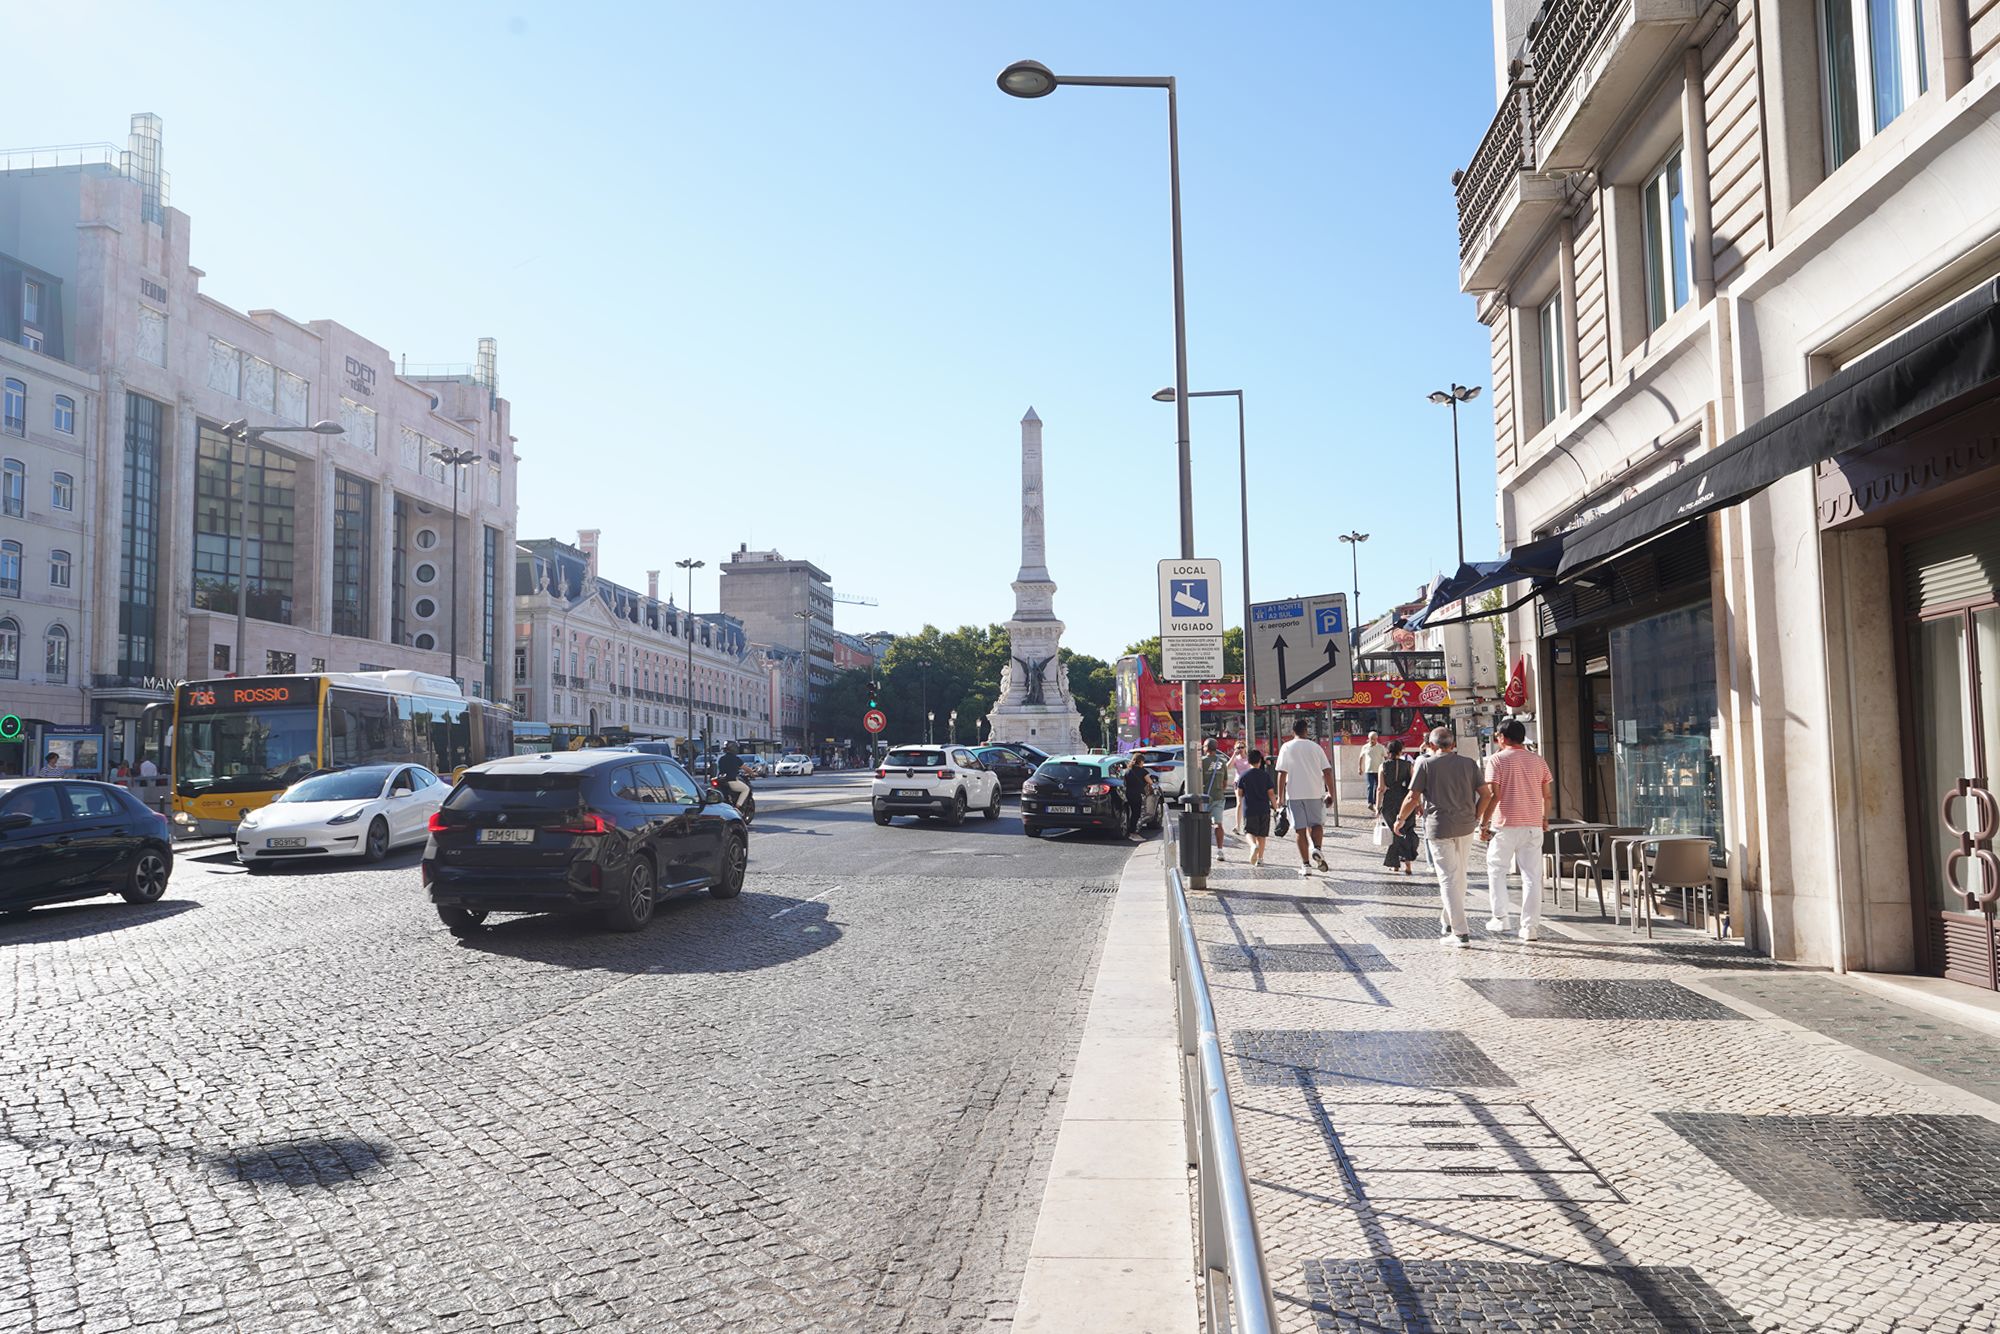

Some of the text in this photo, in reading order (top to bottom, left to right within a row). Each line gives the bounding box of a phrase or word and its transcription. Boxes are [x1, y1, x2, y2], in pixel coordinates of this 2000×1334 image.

[345, 356, 376, 385] EDEN
[1173, 566, 1206, 575] LOCAL
[1278, 602, 1302, 611] NORTE
[1278, 611, 1293, 619] SUL
[1171, 622, 1214, 632] VIGIADO
[1267, 620, 1300, 630] aeroporto
[234, 688, 289, 703] ROSSIO
